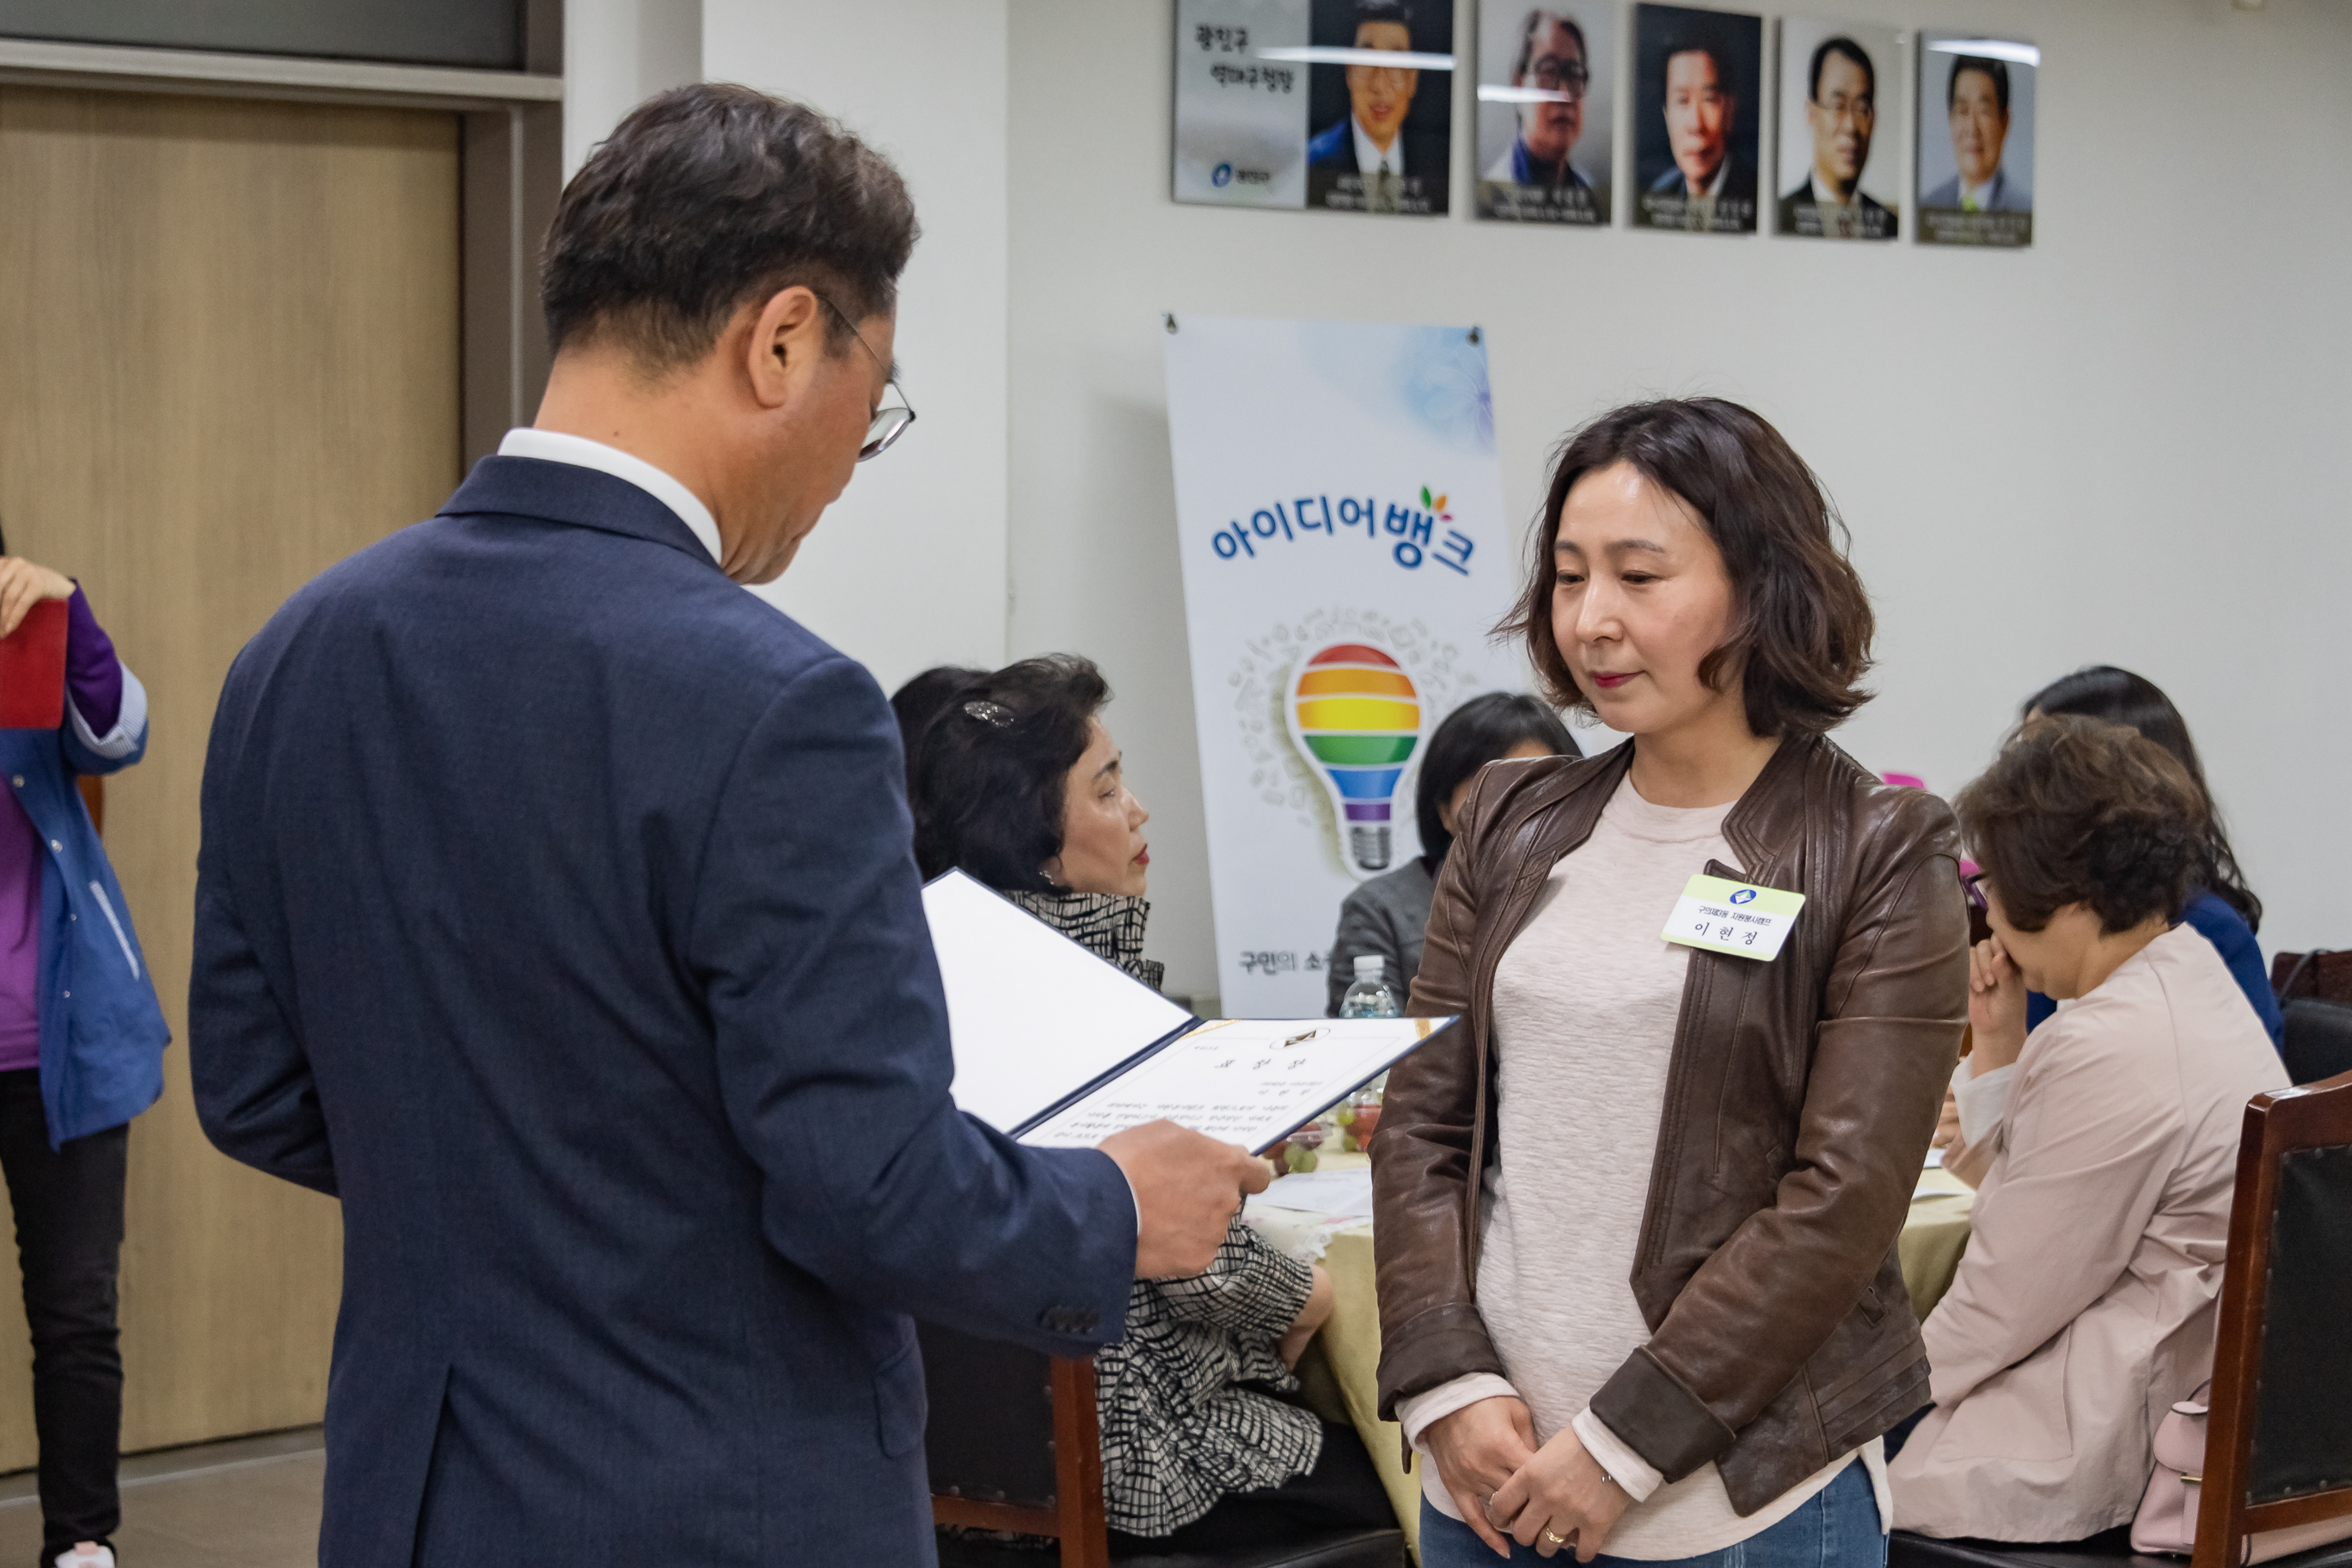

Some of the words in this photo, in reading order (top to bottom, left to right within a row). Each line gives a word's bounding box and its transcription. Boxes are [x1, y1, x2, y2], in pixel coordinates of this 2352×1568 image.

[1211, 495, 1473, 576] 아이디어뱅크
[1238, 950, 1296, 975] 구민의
[1303, 952, 1332, 971] 소
